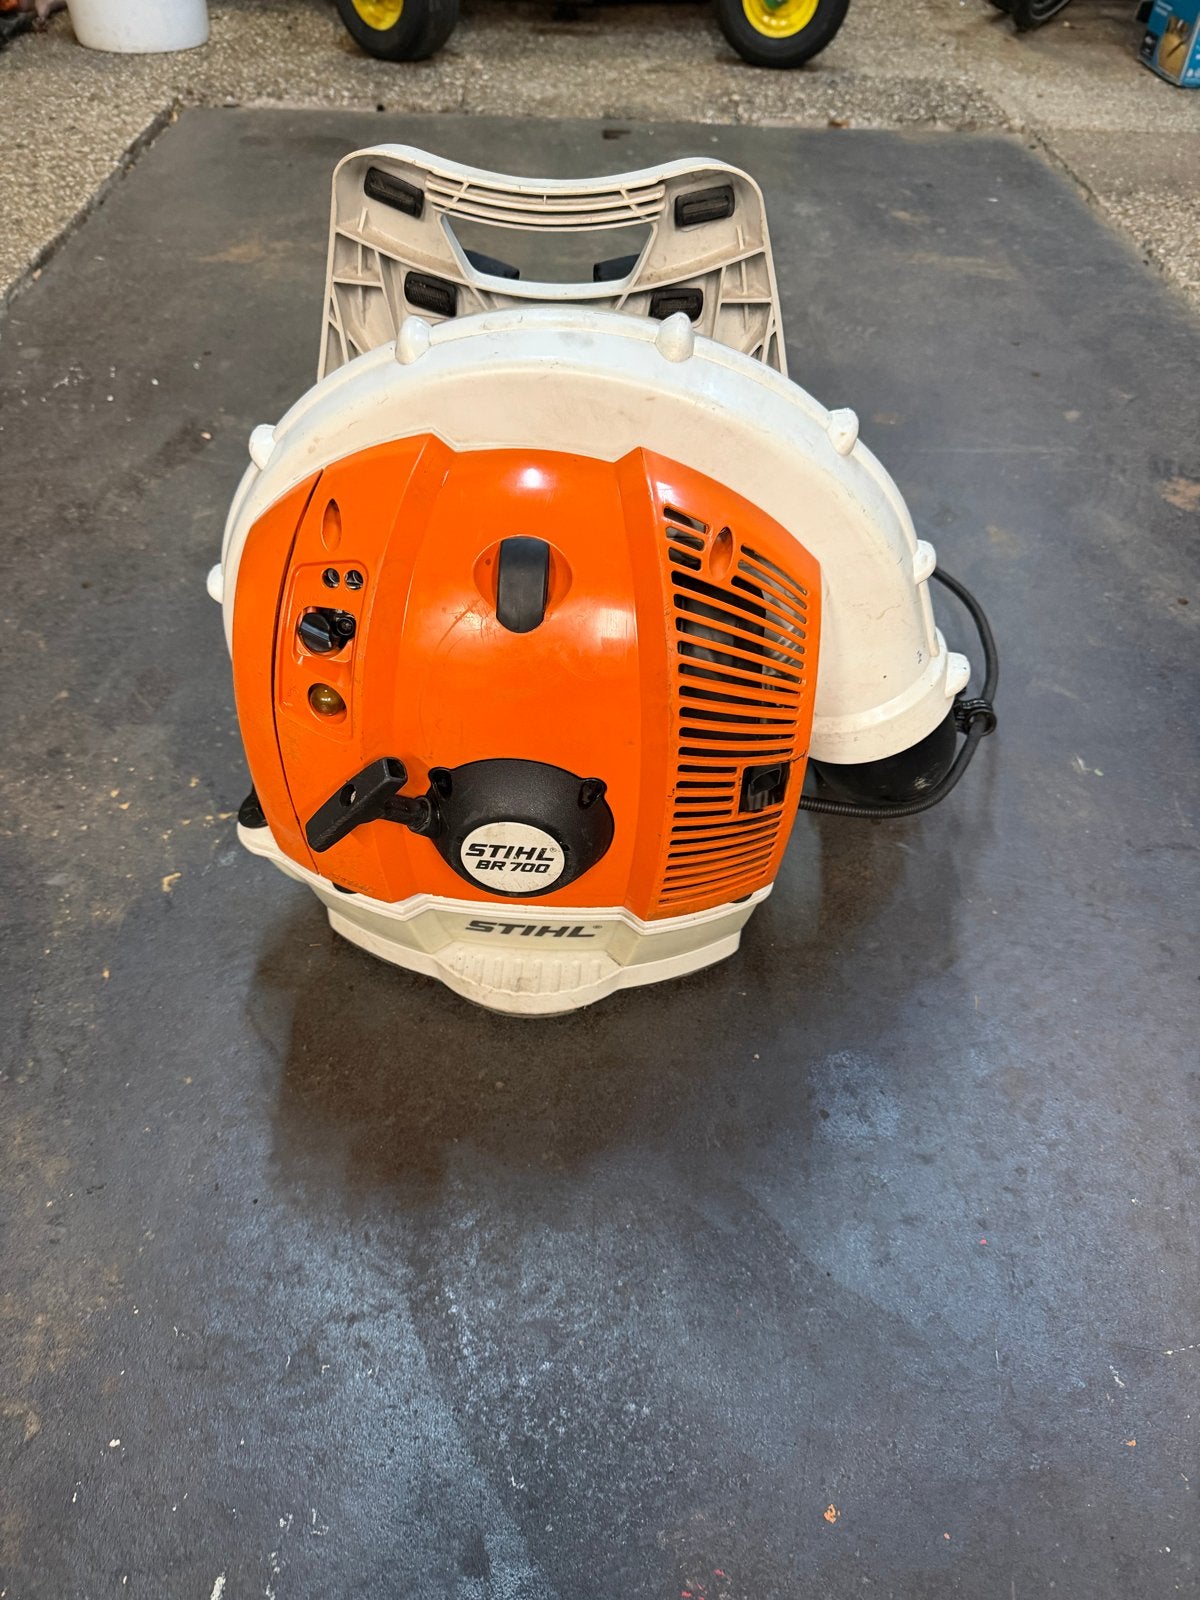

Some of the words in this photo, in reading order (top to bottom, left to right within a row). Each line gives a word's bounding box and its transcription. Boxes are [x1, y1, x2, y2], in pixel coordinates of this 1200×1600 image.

[466, 843, 554, 862] STIHL
[475, 860, 506, 871] BR
[510, 862, 551, 874] 700
[465, 920, 595, 938] STIHL
